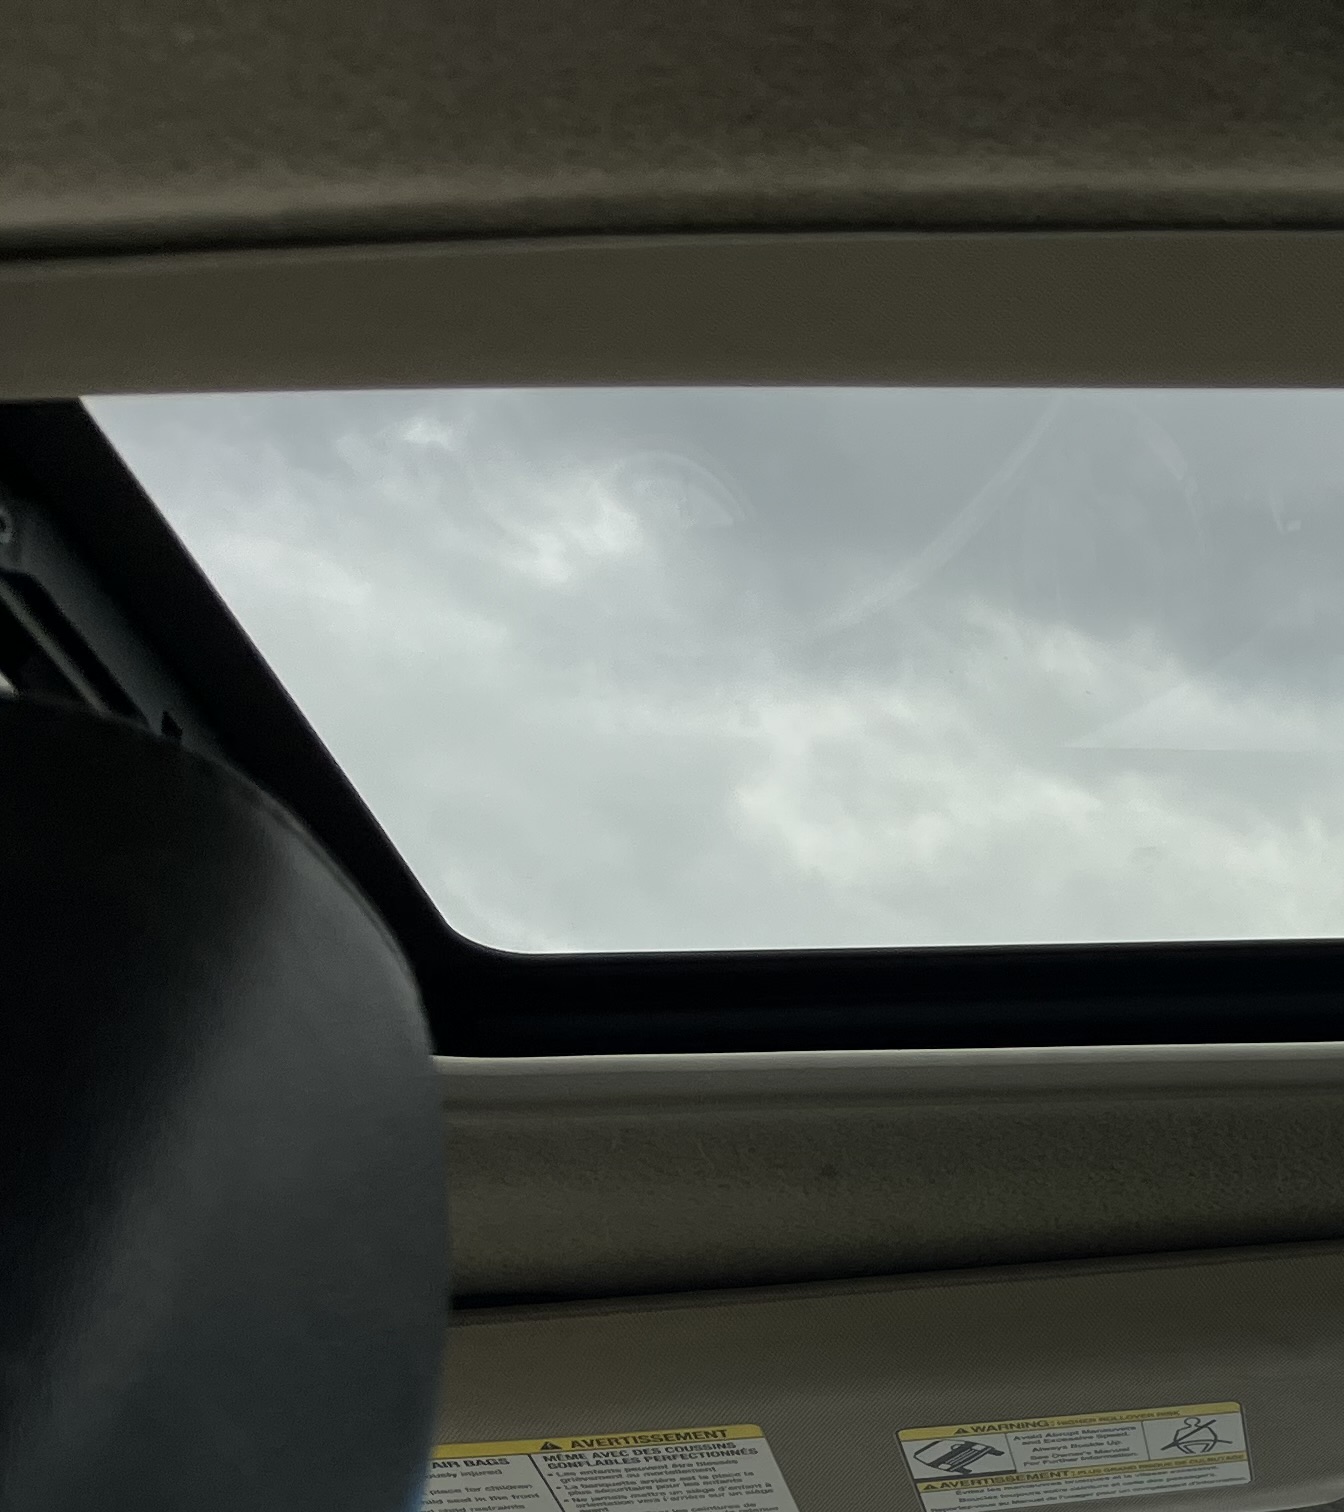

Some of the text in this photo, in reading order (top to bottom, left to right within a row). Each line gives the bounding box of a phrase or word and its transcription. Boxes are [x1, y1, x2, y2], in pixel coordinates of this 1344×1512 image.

[570, 1429, 728, 1449] AVERTISSEMENT
[543, 1441, 737, 1463] MÊME AVEC DES COUSSINS
[433, 1458, 510, 1469] AIR BAGS
